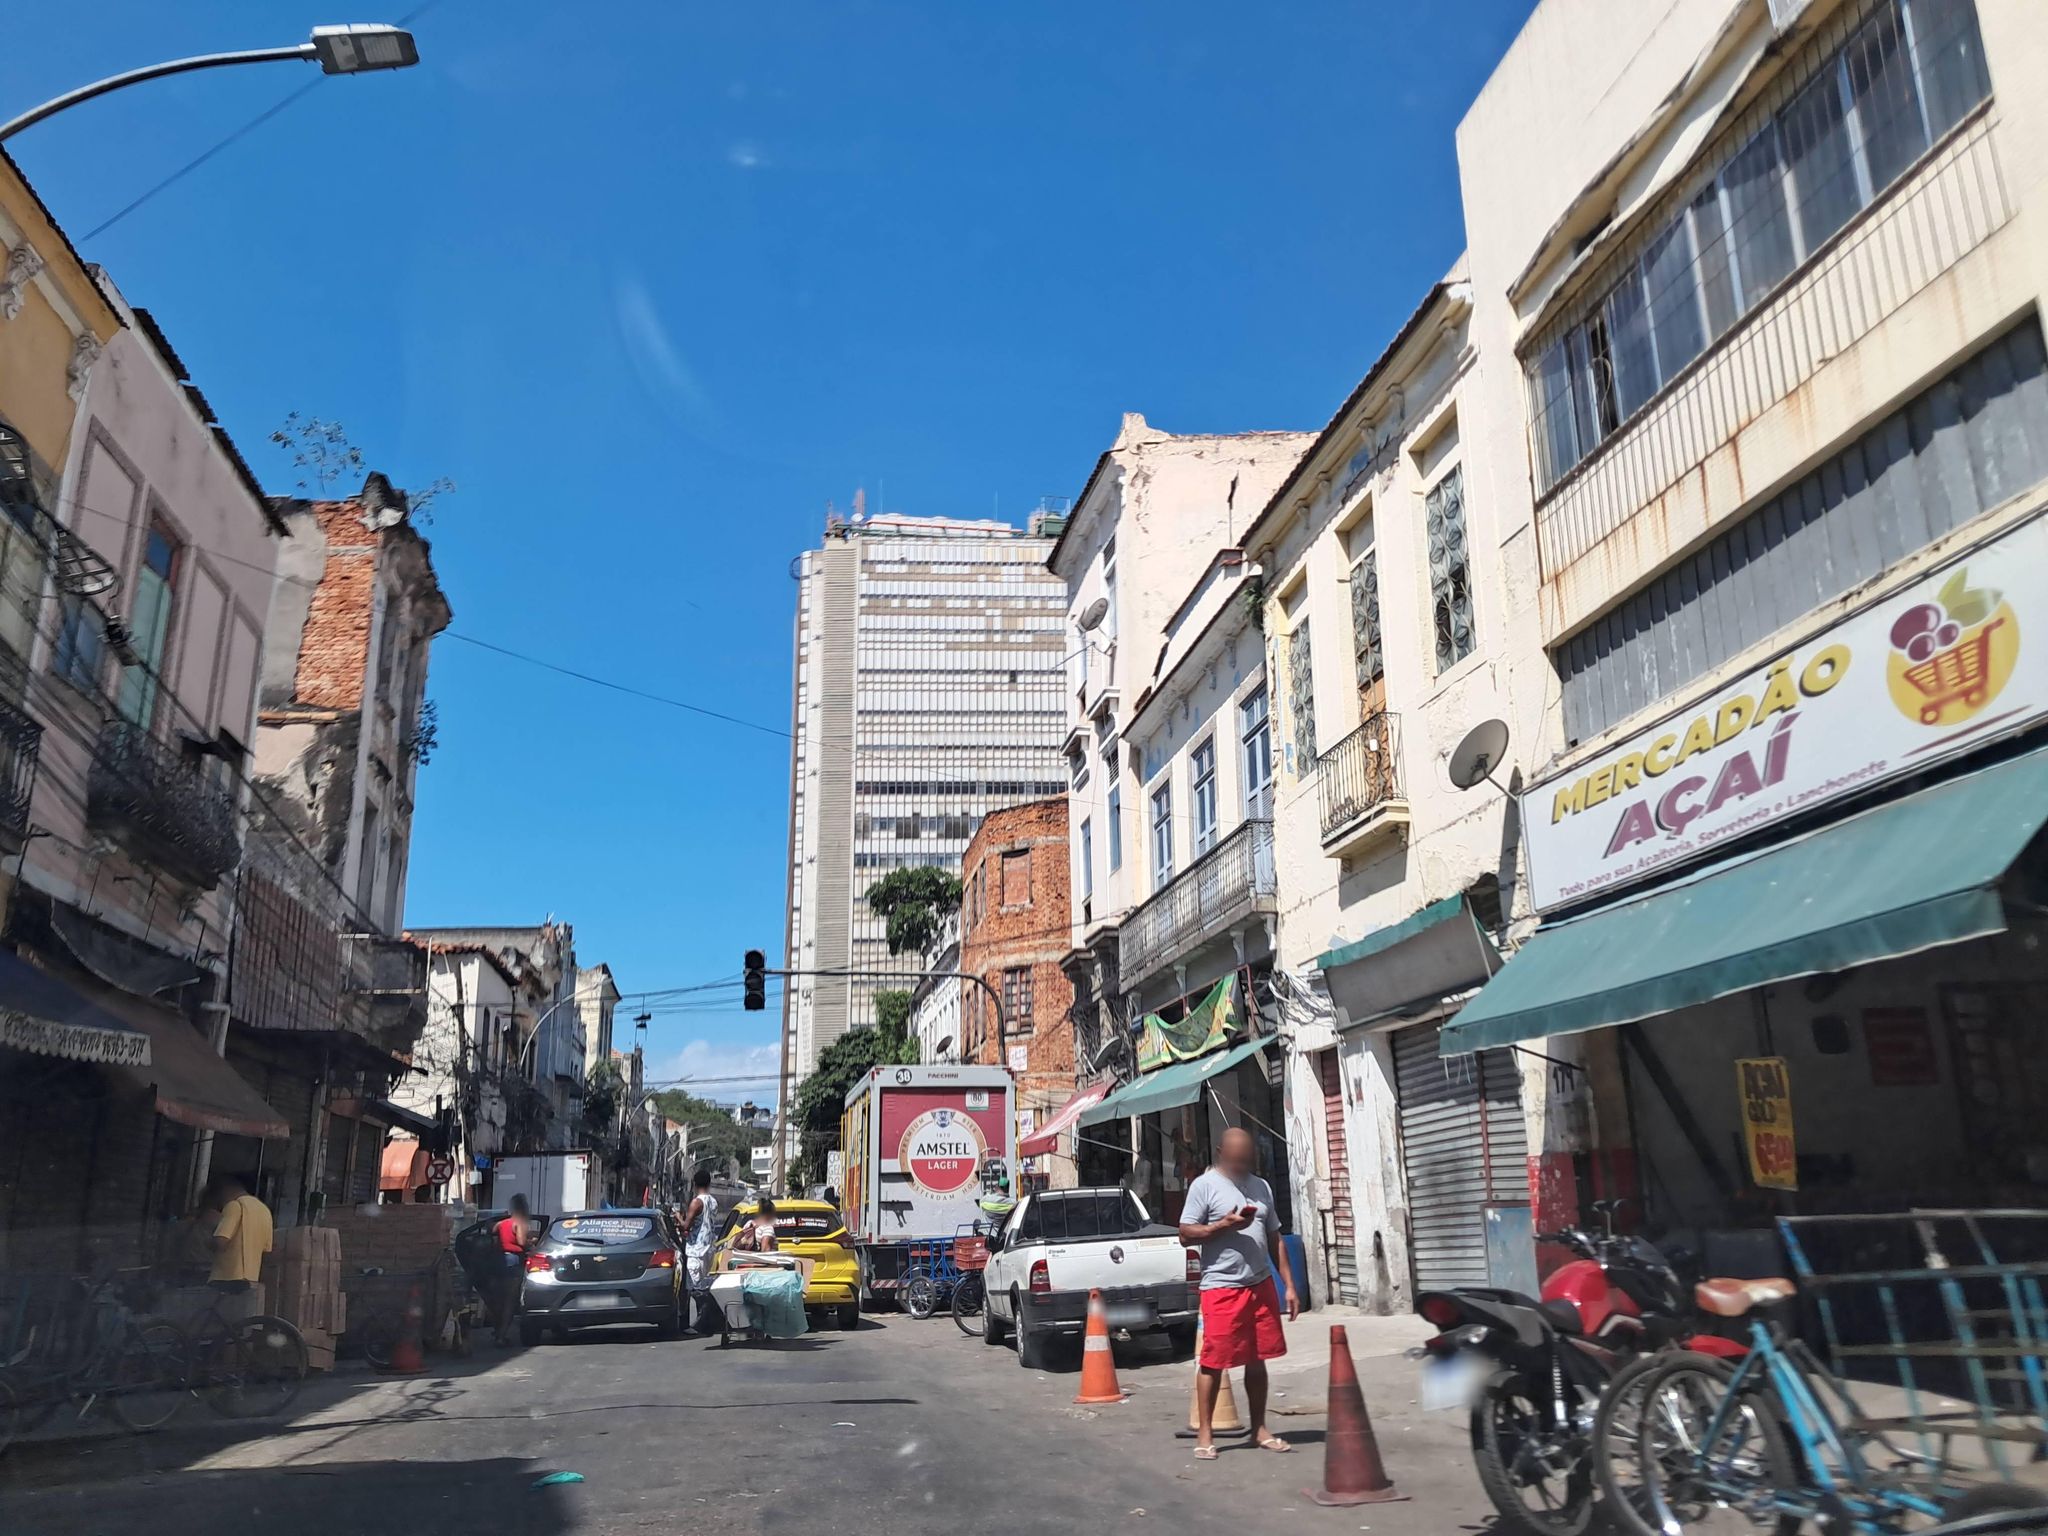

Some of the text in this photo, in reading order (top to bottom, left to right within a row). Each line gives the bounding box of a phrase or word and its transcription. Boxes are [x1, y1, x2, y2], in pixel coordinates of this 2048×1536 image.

[1551, 643, 1853, 825] MERCADÃO
[1602, 711, 1802, 859] AÇAÍ
[1559, 881, 1586, 898] Tudo
[1587, 872, 1613, 890] para
[1614, 864, 1634, 879] sua
[1698, 807, 1770, 843] Sorveteria
[1774, 802, 1784, 813] e
[1787, 759, 1888, 807] Lanchonete
[897, 1069, 911, 1083] 38
[901, 1117, 925, 1154] PREMIUM
[916, 1142, 971, 1156] AMSTEL
[927, 1160, 958, 1170] LAGER
[909, 1181, 955, 1200] MSTERDAM
